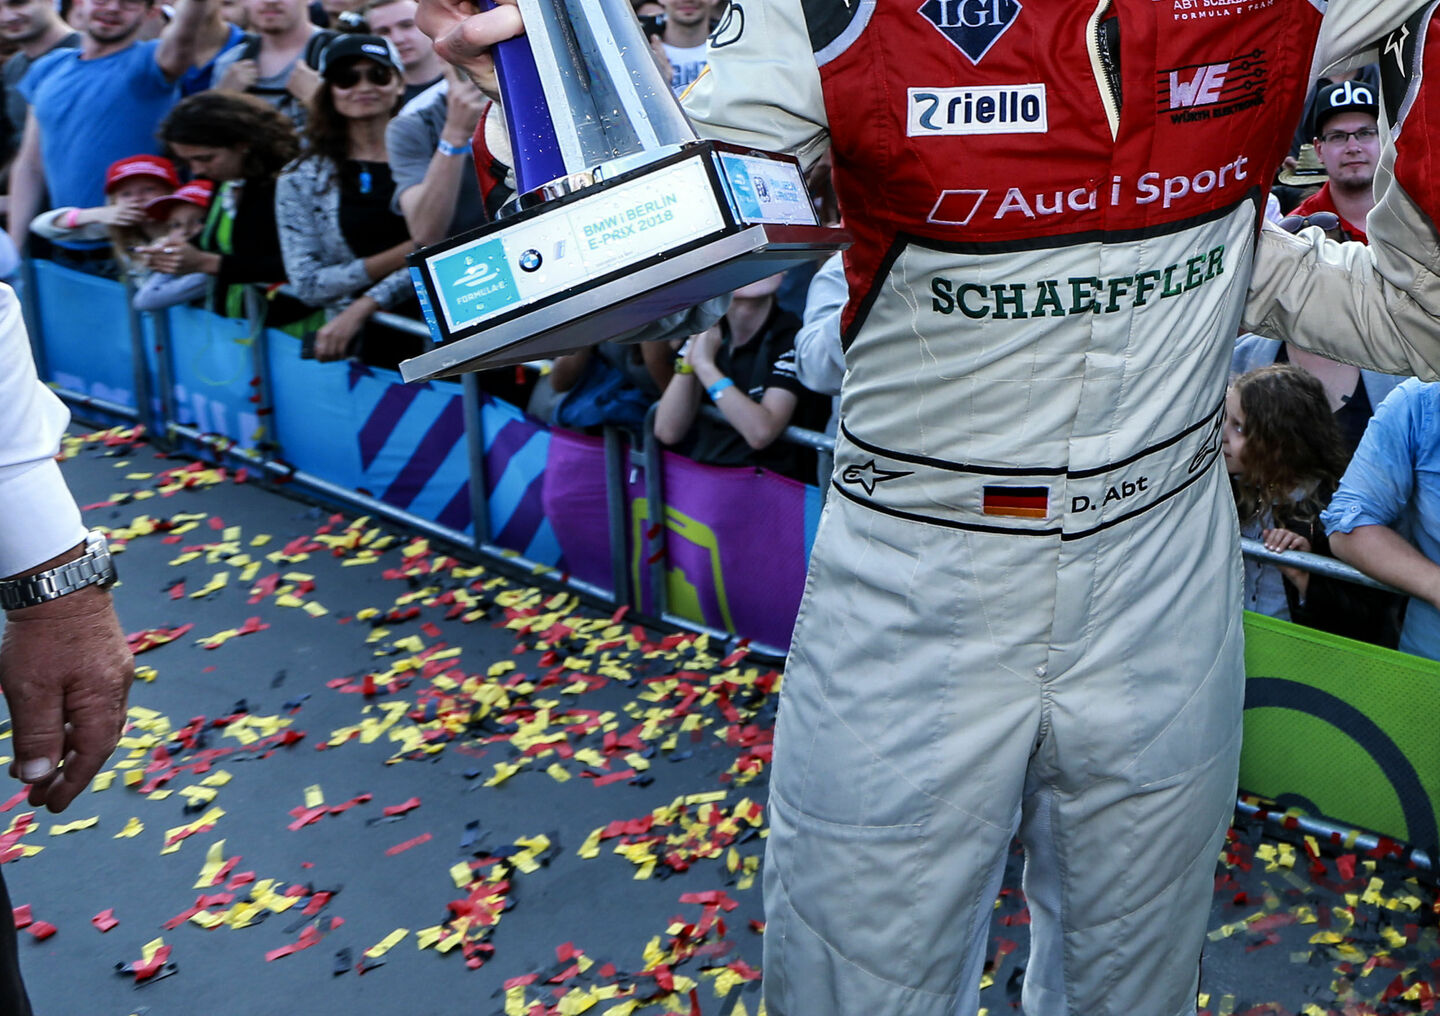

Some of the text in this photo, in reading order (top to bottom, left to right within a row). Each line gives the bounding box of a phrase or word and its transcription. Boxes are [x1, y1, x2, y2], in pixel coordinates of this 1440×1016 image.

[1173, 0, 1275, 21] FORMULA E TEAM
[1169, 62, 1231, 110] WE
[1330, 80, 1374, 107] da
[946, 88, 1041, 128] riello
[1170, 109, 1211, 125] WÜRTH
[994, 154, 1250, 221] Audi Sport
[583, 218, 618, 238] BMW
[626, 192, 679, 223] BERLIN
[588, 209, 675, 251] E-PRIX 2018
[932, 244, 1226, 320] SCHAEFFLER
[1071, 475, 1149, 514] D. Abt
